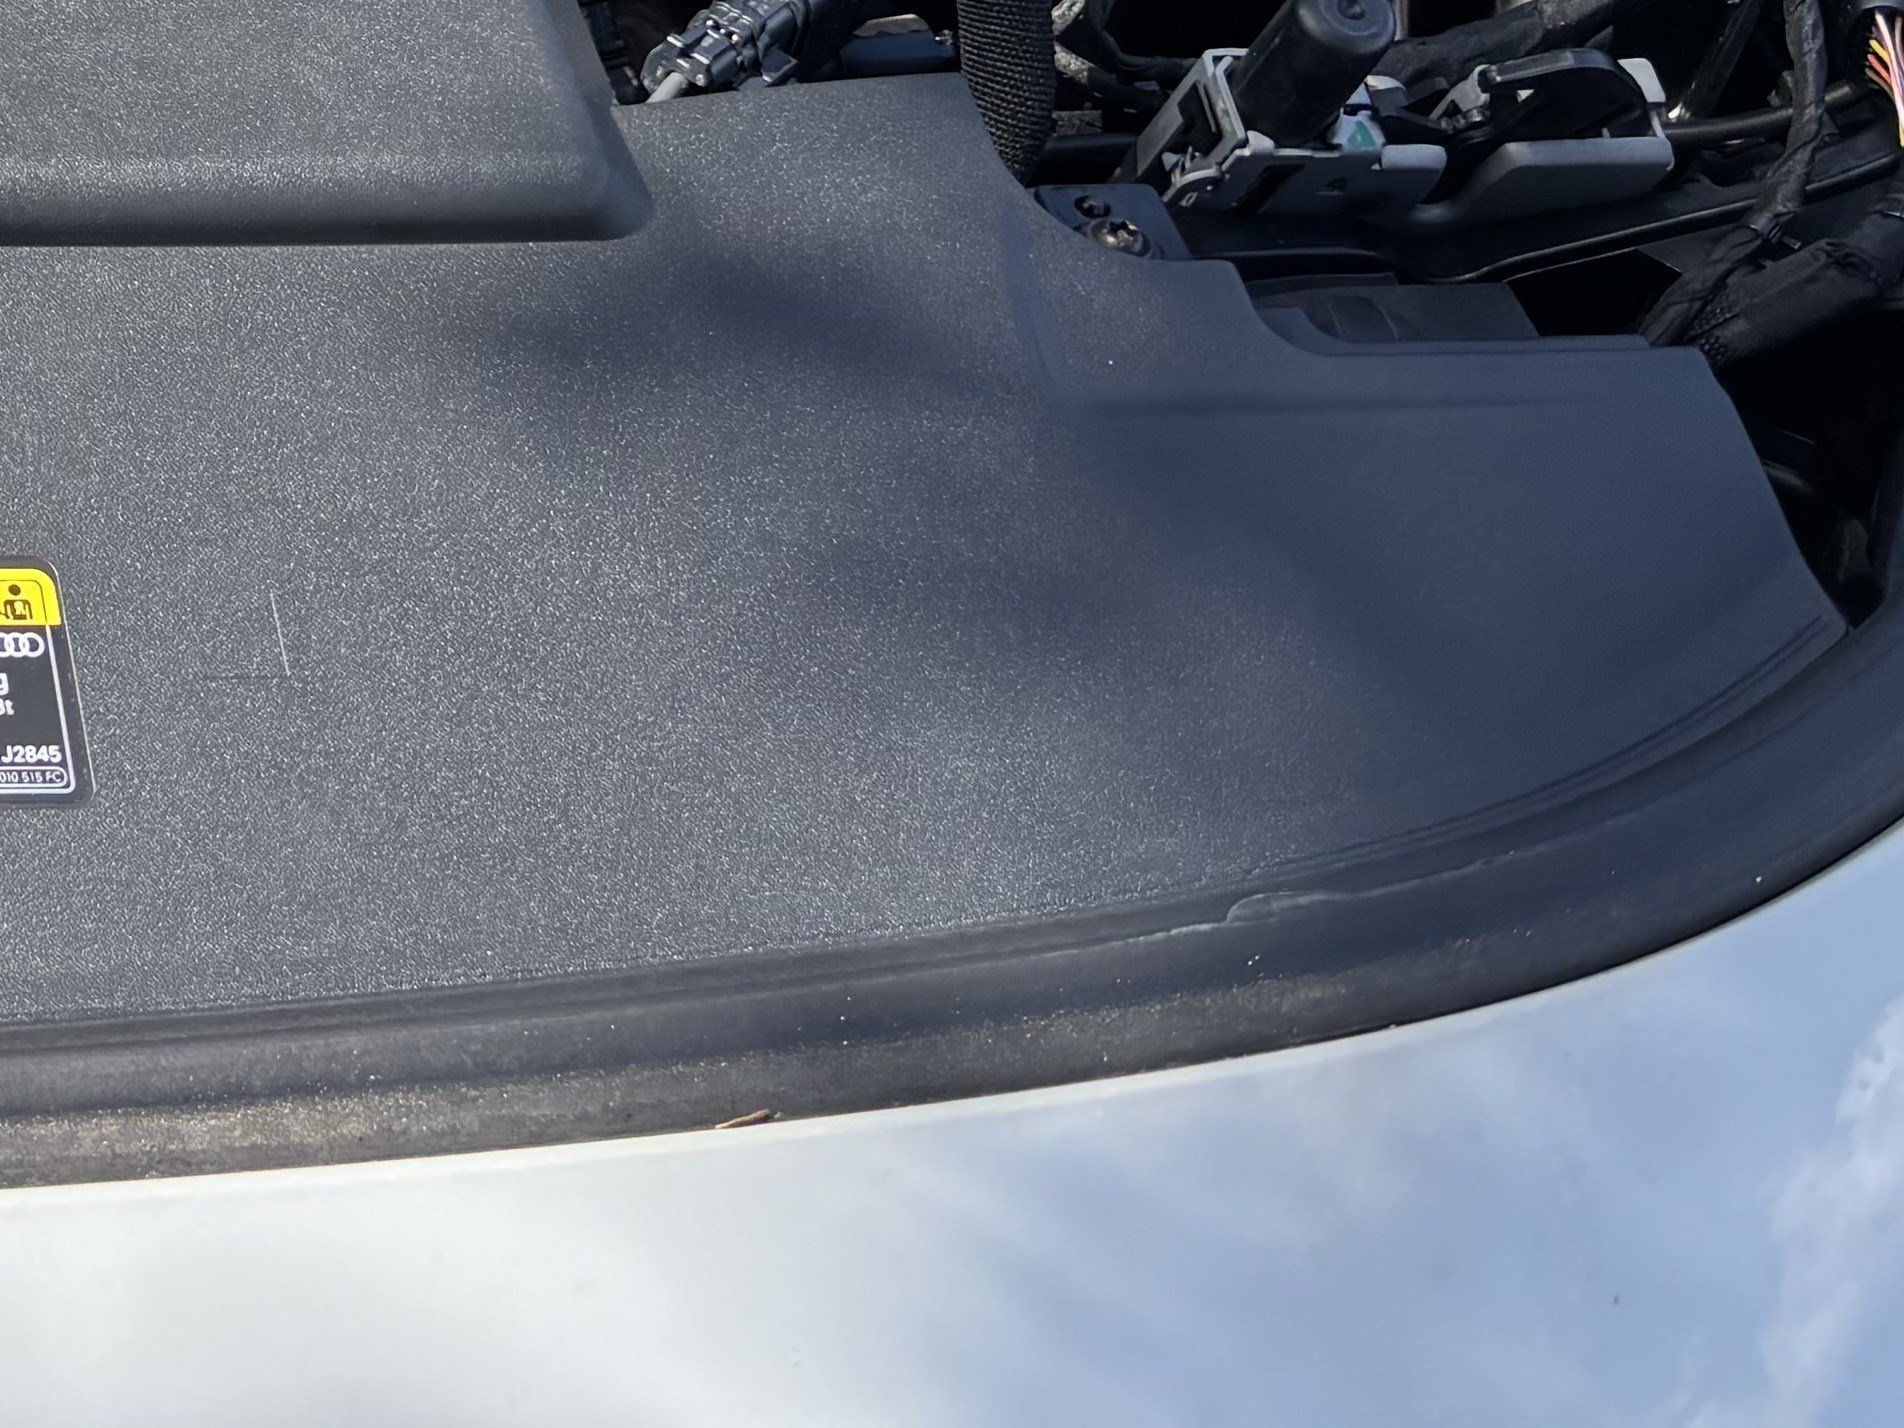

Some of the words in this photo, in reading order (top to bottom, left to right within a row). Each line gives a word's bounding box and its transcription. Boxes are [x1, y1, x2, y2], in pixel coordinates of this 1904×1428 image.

[1, 745, 62, 763] J2845
[0, 771, 18, 782] 010
[22, 771, 43, 782] 515
[46, 771, 62, 782] FC
